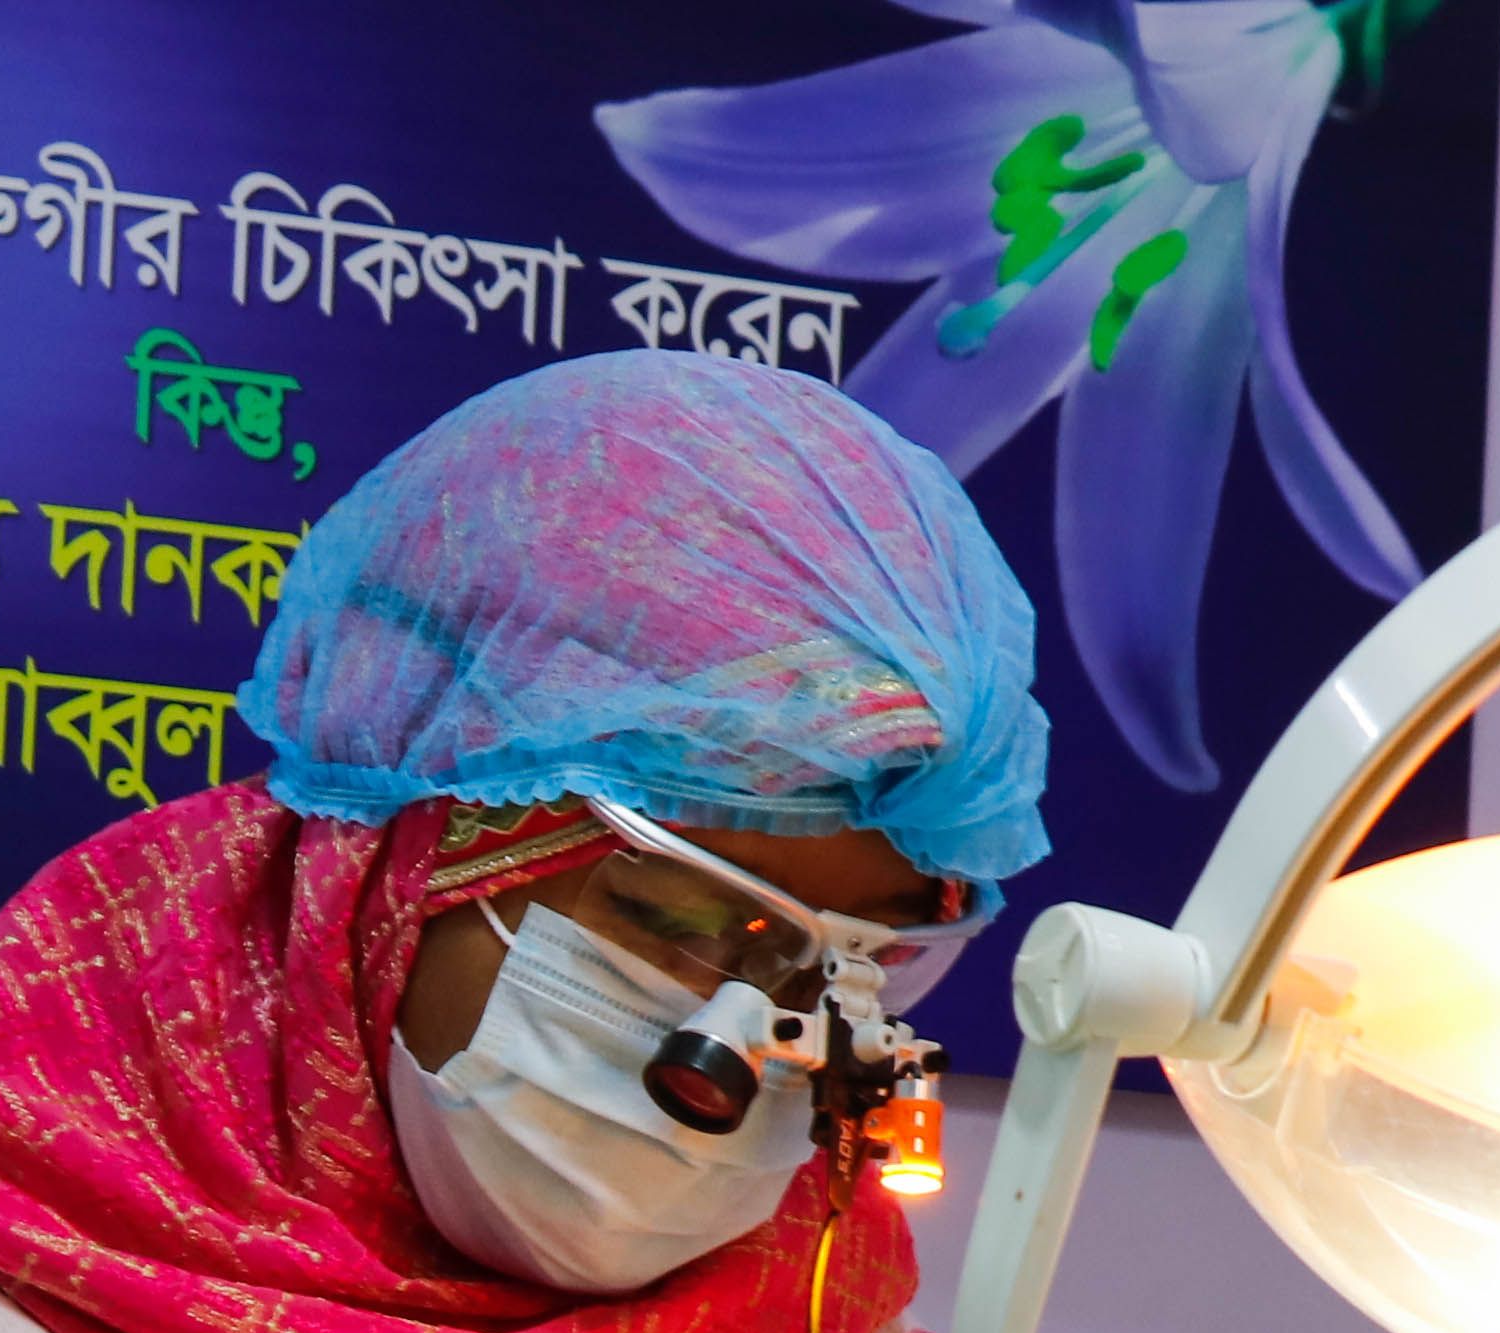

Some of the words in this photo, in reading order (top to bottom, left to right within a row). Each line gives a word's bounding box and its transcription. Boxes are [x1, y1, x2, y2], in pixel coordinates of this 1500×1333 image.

[218, 172, 584, 350] চিকিৎসা
[600, 257, 862, 388] করেন
[38, 498, 310, 627] দানক
